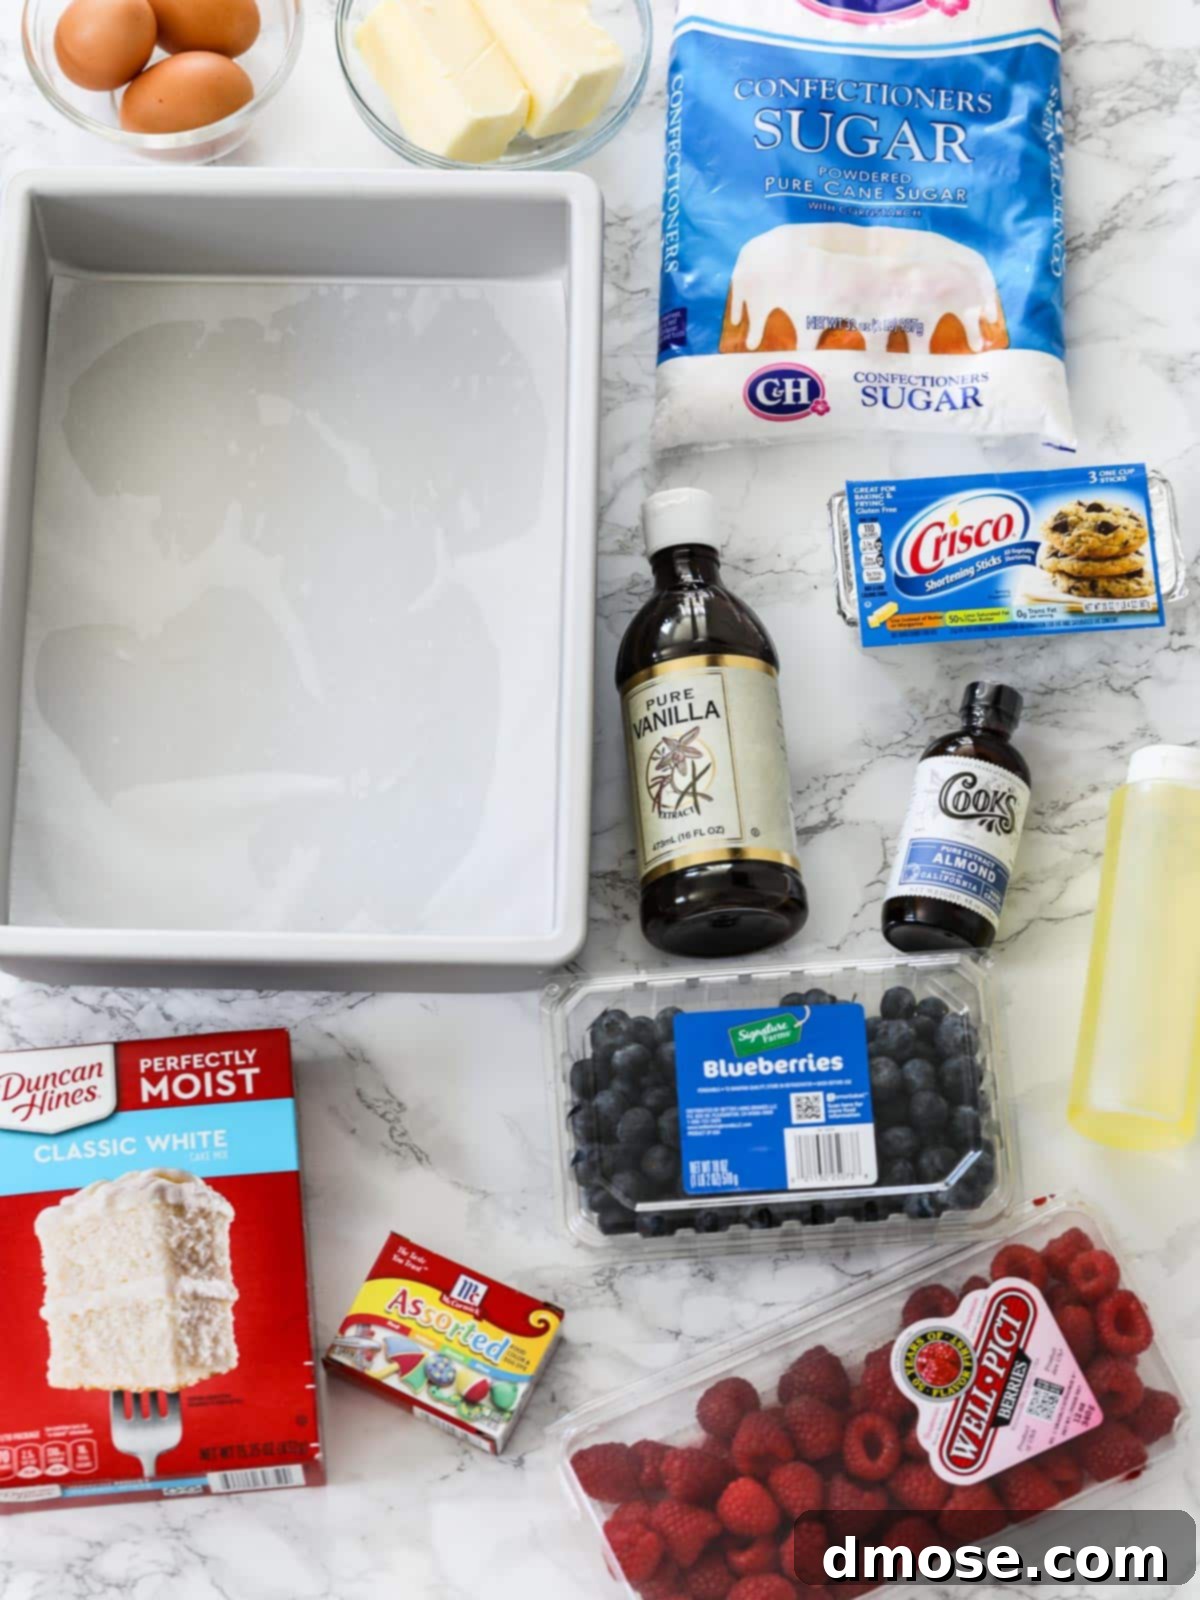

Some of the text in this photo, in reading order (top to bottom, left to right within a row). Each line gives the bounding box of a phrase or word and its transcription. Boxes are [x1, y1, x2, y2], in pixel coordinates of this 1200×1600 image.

[733, 77, 992, 114] CONFECTIONERS
[753, 107, 974, 164] SUGAR
[662, 73, 685, 275] CONFECTIONERS
[764, 176, 967, 202] PURE CANE SUGAR
[818, 166, 912, 184] POWDERED
[756, 377, 811, 406] C&H
[853, 371, 989, 387] CONFECTIONERS
[861, 386, 983, 412] SUGAR
[1088, 471, 1098, 484] 3
[910, 513, 1014, 575] Crisco
[925, 555, 1002, 592] Shortening Sticks
[645, 688, 694, 711] PURE
[632, 700, 720, 740] VANILLA
[920, 871, 978, 892] CALIFORNIA
[932, 853, 997, 883] ALMOND
[738, 1021, 788, 1044] Signature
[763, 1030, 791, 1043] Farms
[139, 1049, 257, 1073] PERFECTLY
[703, 1053, 844, 1078] Blueberries
[0, 1062, 103, 1101] Duncan
[140, 1067, 261, 1103] MOIST
[12, 1084, 98, 1122] Hines
[34, 1129, 228, 1164] CLASSIC WHITE
[386, 1288, 510, 1362] Assorted
[905, 1337, 924, 1376] YEARS
[926, 1331, 944, 1341] OF
[950, 1335, 972, 1367] FIRST
[932, 1370, 970, 1397] FLAVOR
[997, 1360, 1028, 1420] BERRIES
